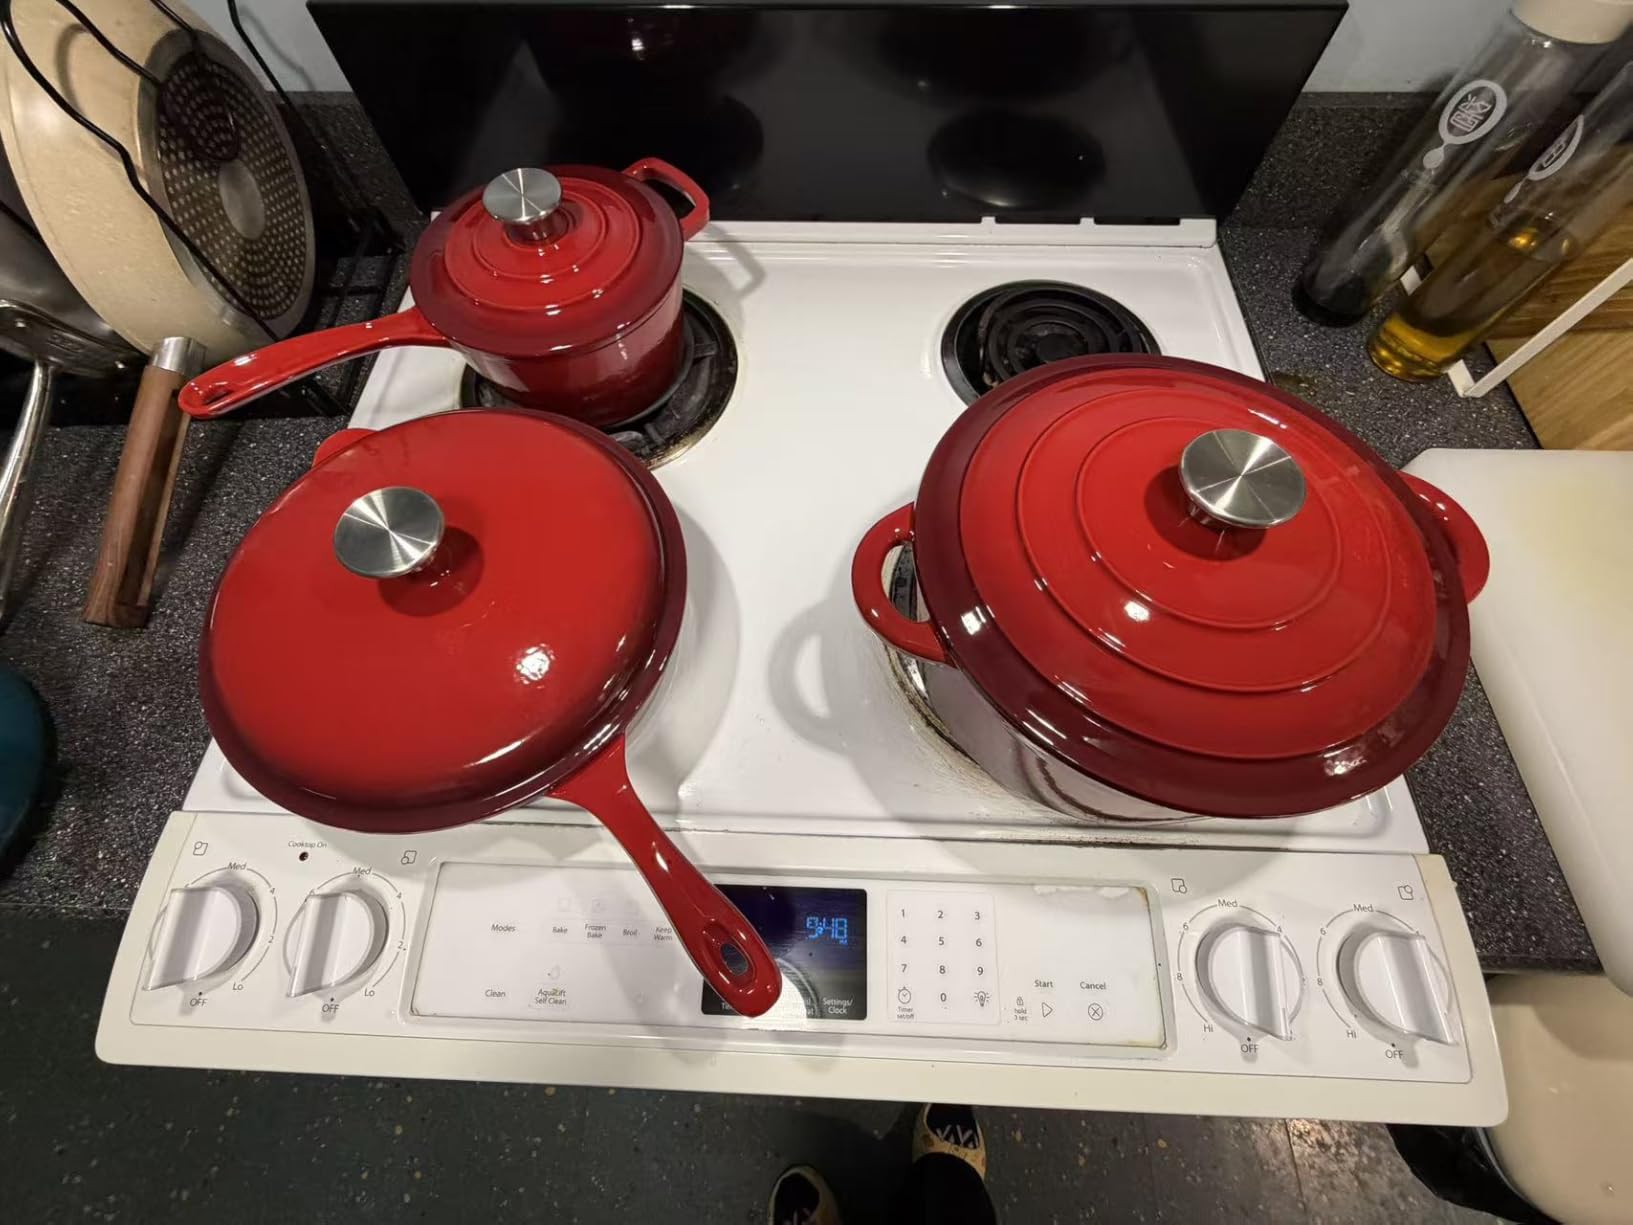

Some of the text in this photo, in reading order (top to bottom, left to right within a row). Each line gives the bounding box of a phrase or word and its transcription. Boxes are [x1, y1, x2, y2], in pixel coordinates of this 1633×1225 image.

[288, 840, 328, 849] Cooktop On
[228, 862, 247, 870] Med
[353, 866, 373, 875] Med
[1217, 899, 1239, 908] Med
[900, 908, 906, 918] 1
[1352, 904, 1374, 913] Med
[937, 909, 944, 919] 2
[974, 911, 981, 921] 3
[490, 924, 517, 933] Modes
[552, 926, 568, 934] Bake
[584, 924, 607, 932] Frozen
[655, 926, 673, 935] Keep
[1182, 922, 1189, 931] 6
[586, 931, 603, 939] Bake
[622, 928, 638, 937] Broil
[1320, 927, 1327, 936] 6
[268, 935, 275, 944] 2
[900, 935, 907, 944] 4
[938, 936, 945, 946] 5
[975, 938, 982, 948] 6
[901, 963, 908, 973] 7
[939, 965, 946, 974] 8
[976, 966, 984, 976] 9
[1176, 972, 1183, 981] 8
[1034, 979, 1054, 989] Start
[1079, 981, 1107, 990] Cancel
[1317, 977, 1323, 986] 8
[232, 982, 244, 991] Lo
[364, 988, 375, 997] Lo
[485, 989, 506, 998] Clean
[940, 992, 947, 1002] 0
[189, 998, 207, 1007] OFF
[535, 997, 567, 1006] Self Clean
[822, 997, 854, 1007] Settings/
[321, 1003, 340, 1013] OFF
[828, 1006, 848, 1015] Clock
[1203, 1023, 1214, 1033] Hi
[1346, 1029, 1358, 1039] Hi
[1240, 1043, 1258, 1053] OFF
[1384, 1049, 1404, 1059] OFF
